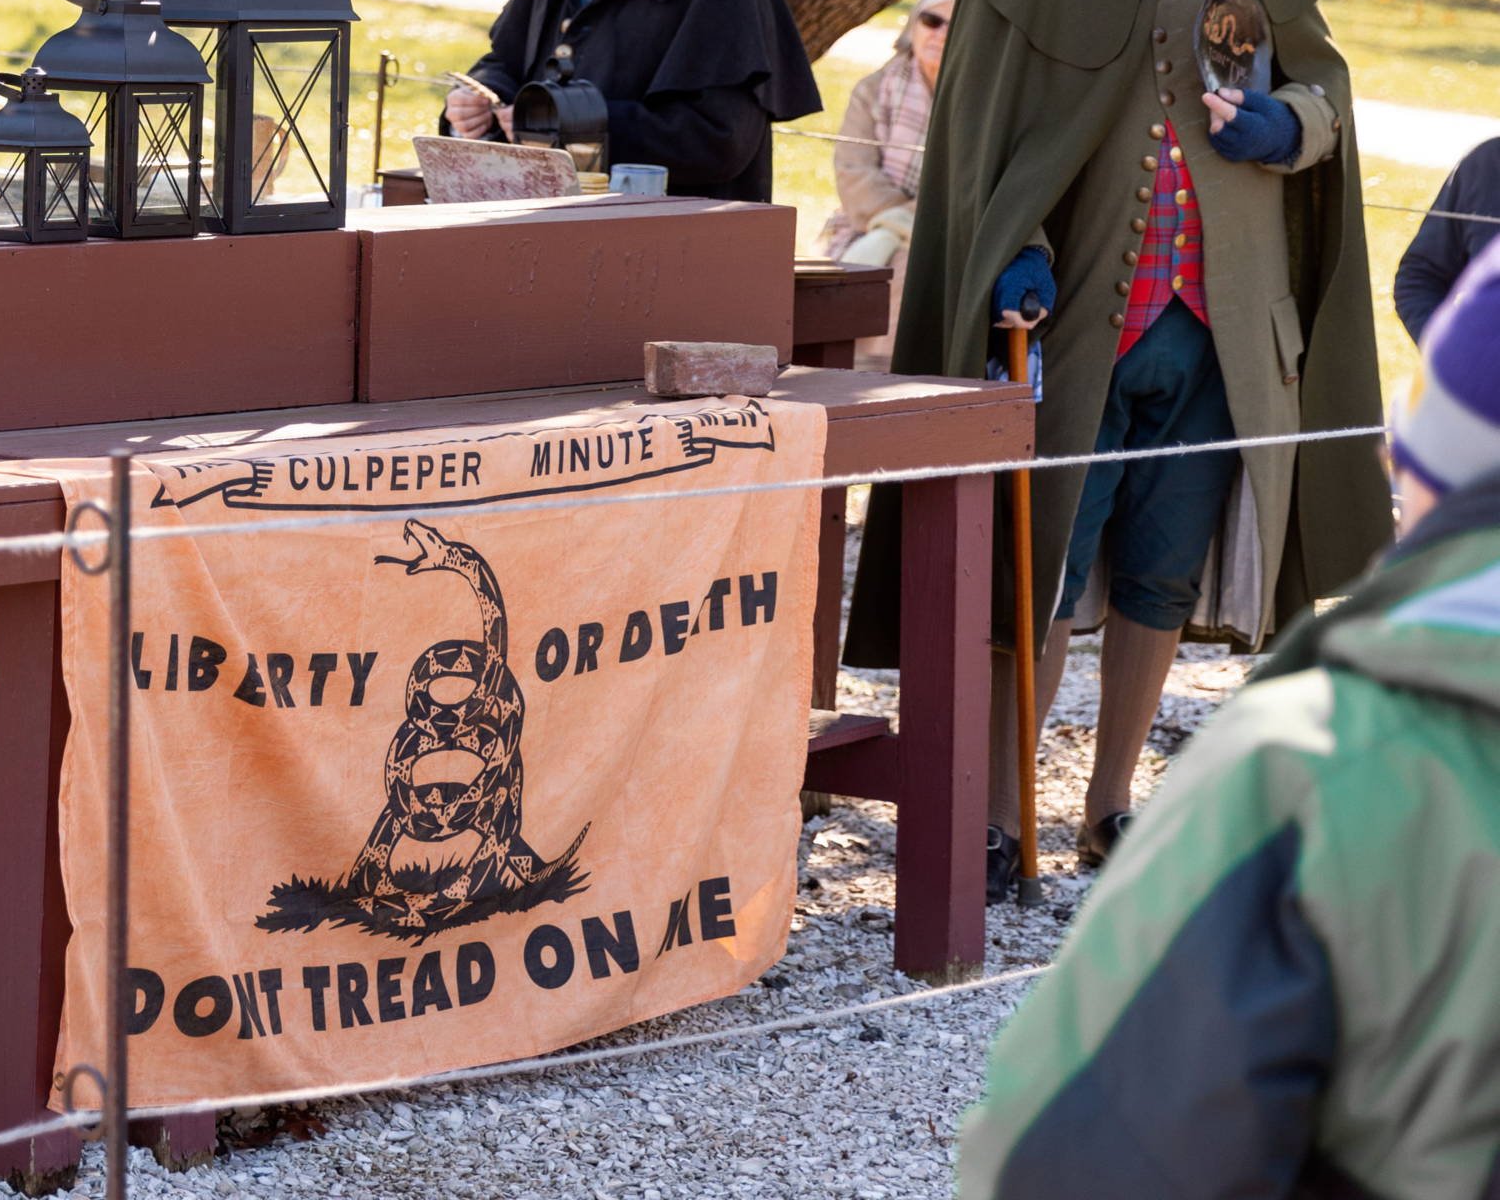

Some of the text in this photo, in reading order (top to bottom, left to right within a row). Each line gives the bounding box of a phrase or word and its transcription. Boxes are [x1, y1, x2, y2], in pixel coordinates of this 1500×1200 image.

[288, 451, 482, 491] CULPEPER
[529, 426, 654, 478] MINUTE
[131, 570, 778, 709] LIBERTY OR DETH
[302, 941, 496, 1032] TREAD
[523, 909, 640, 990] ON
